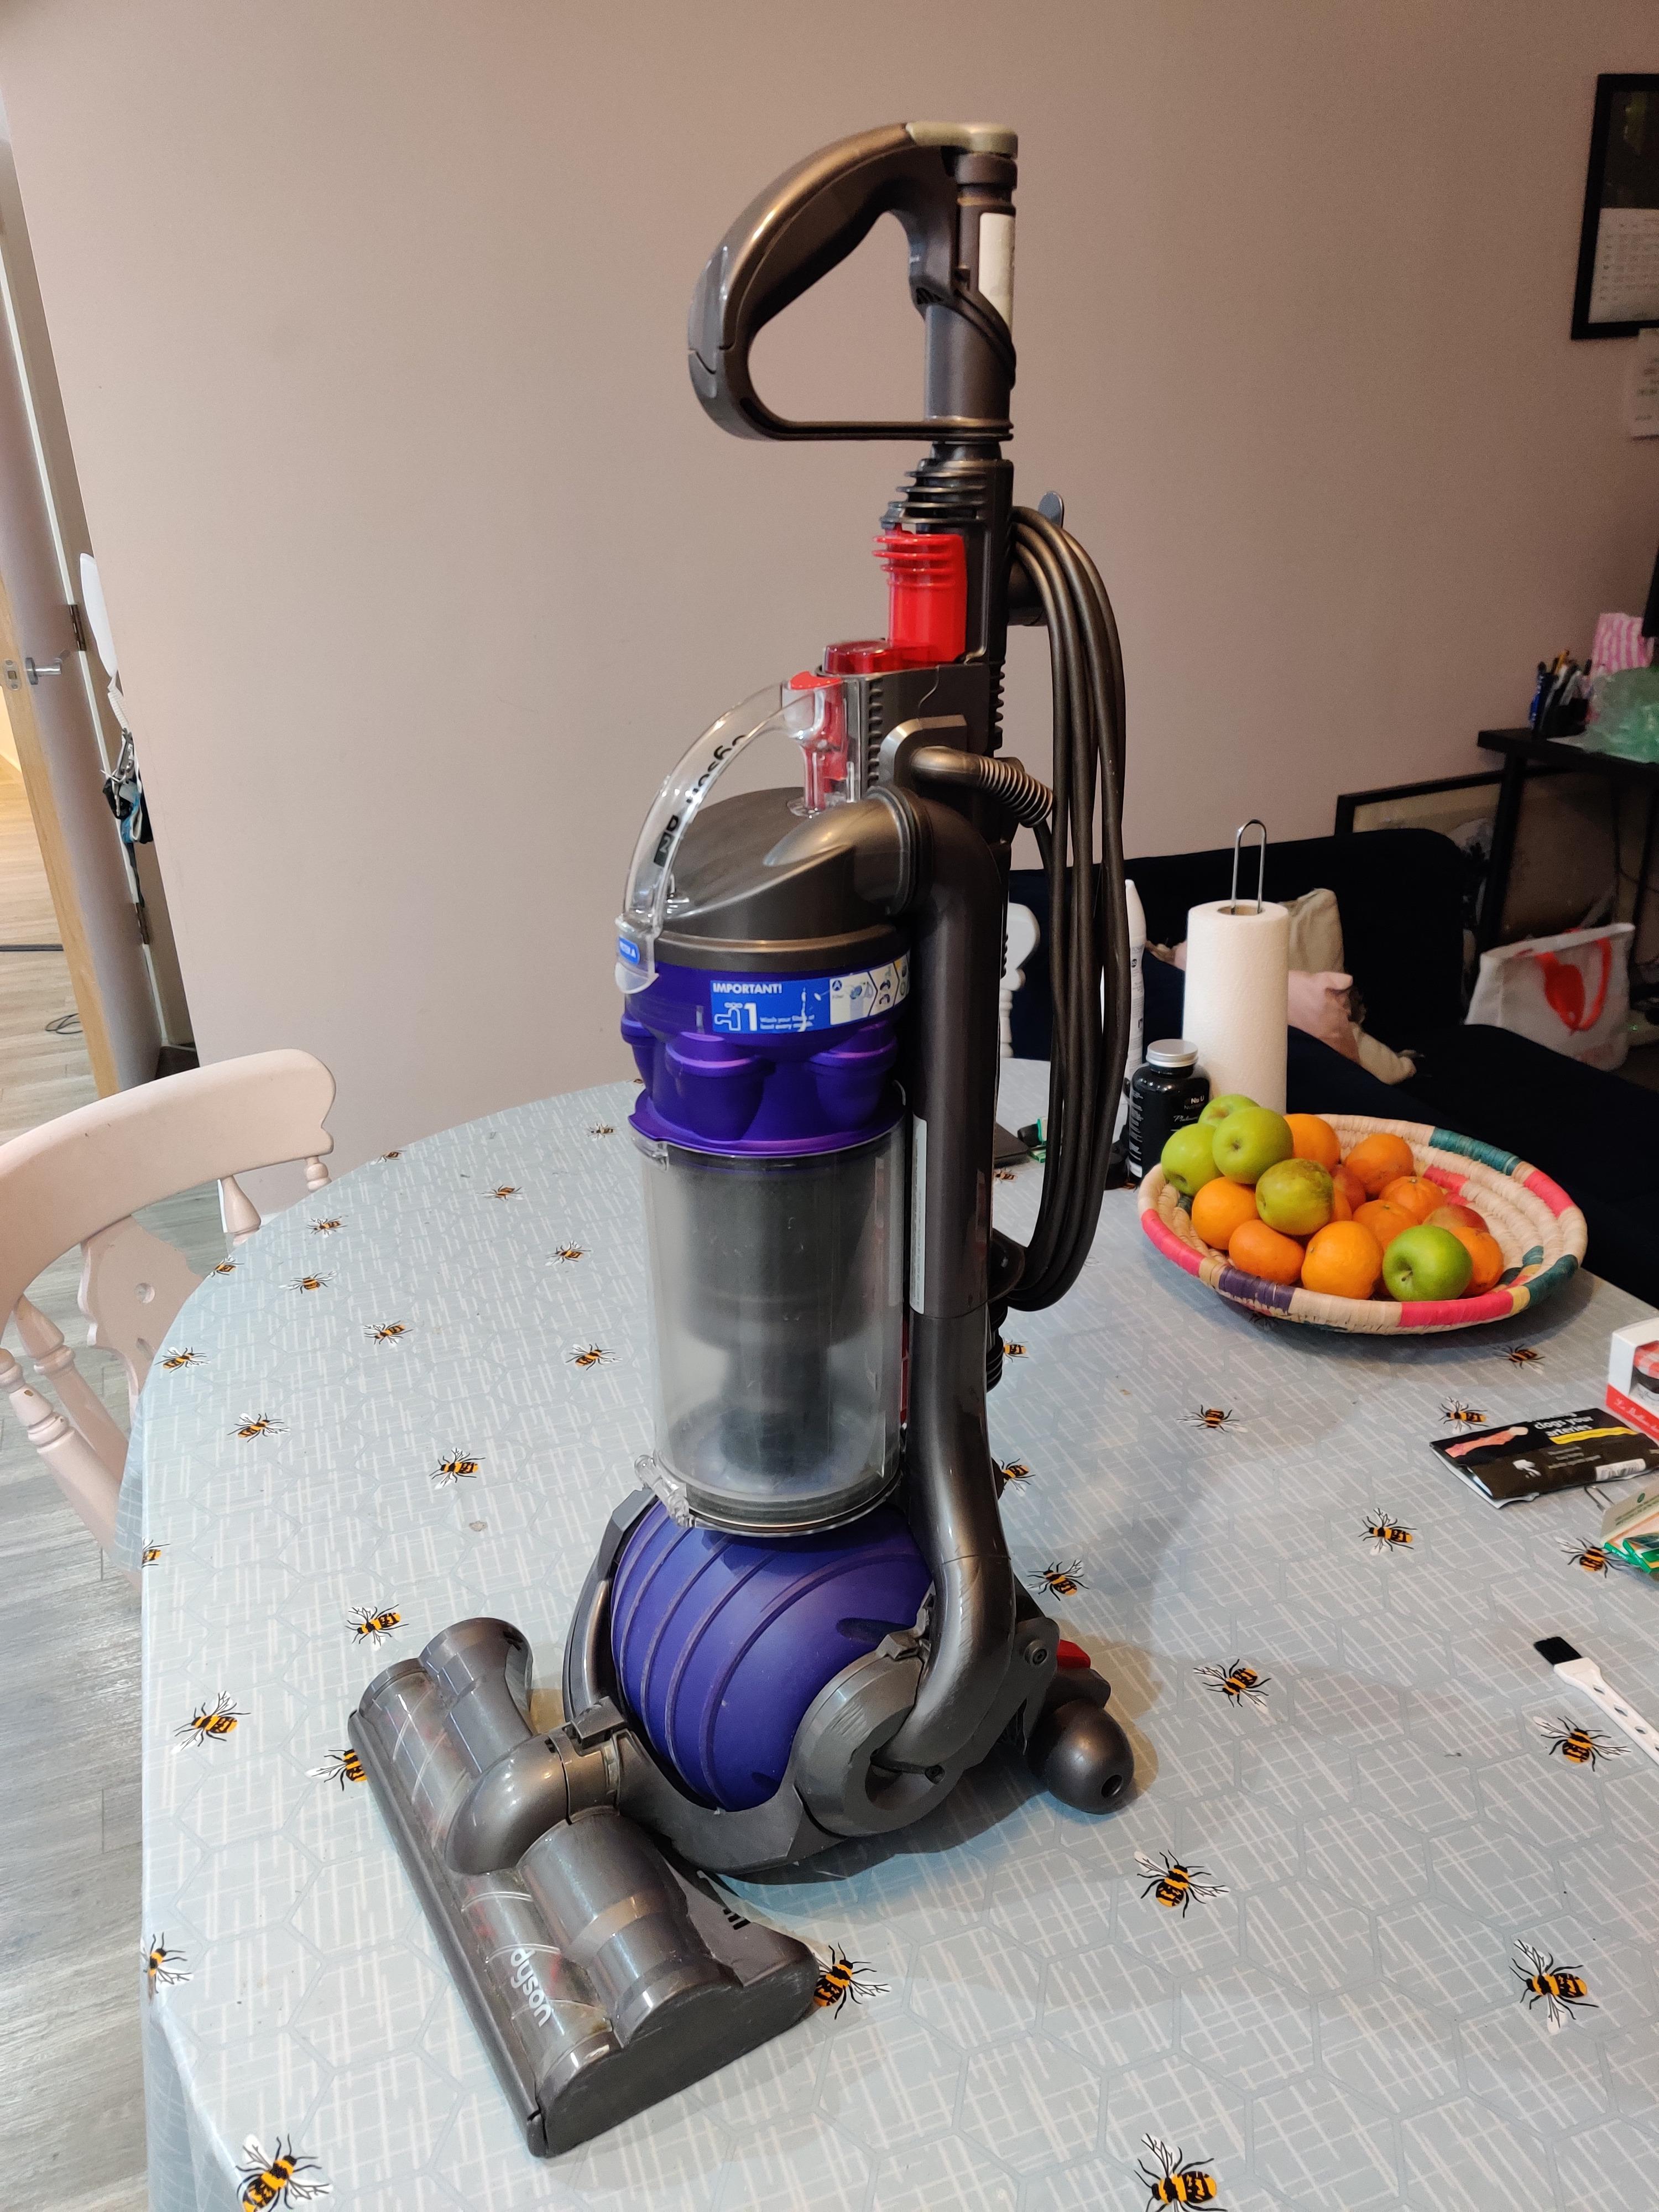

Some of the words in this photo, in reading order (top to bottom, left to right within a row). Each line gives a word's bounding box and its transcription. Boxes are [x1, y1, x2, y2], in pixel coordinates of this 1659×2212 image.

[712, 982, 782, 994] IMPORTANT!
[1534, 1420, 1567, 1430] clogs
[1565, 1416, 1594, 1425] your
[1545, 1425, 1593, 1437] arteries
[510, 1948, 552, 2028] dyson
